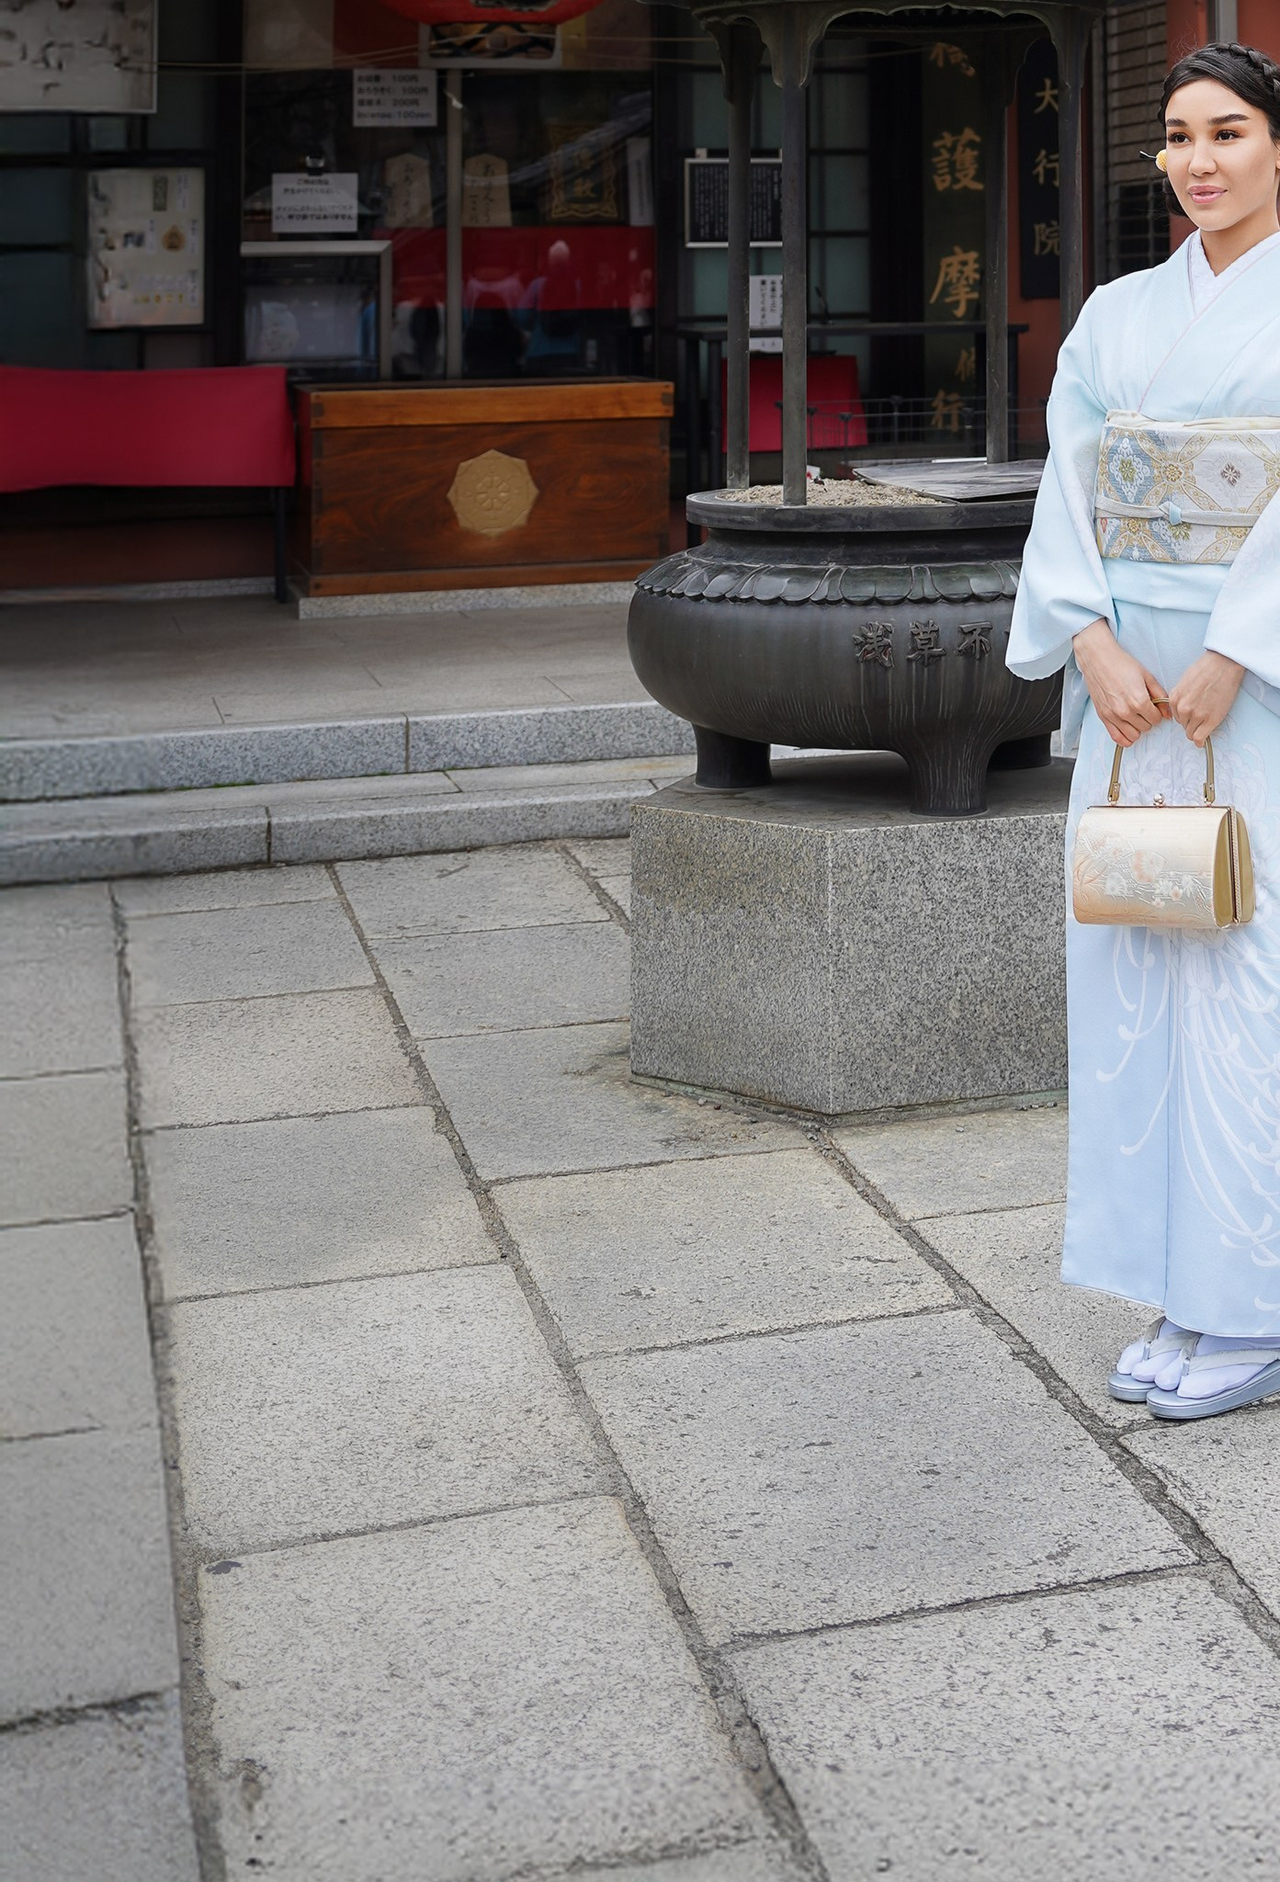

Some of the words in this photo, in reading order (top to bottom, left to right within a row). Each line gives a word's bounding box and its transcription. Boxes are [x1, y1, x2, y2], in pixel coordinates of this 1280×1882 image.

[1032, 78, 1060, 256] 大行院
[852, 619, 1010, 669] 浅草不
